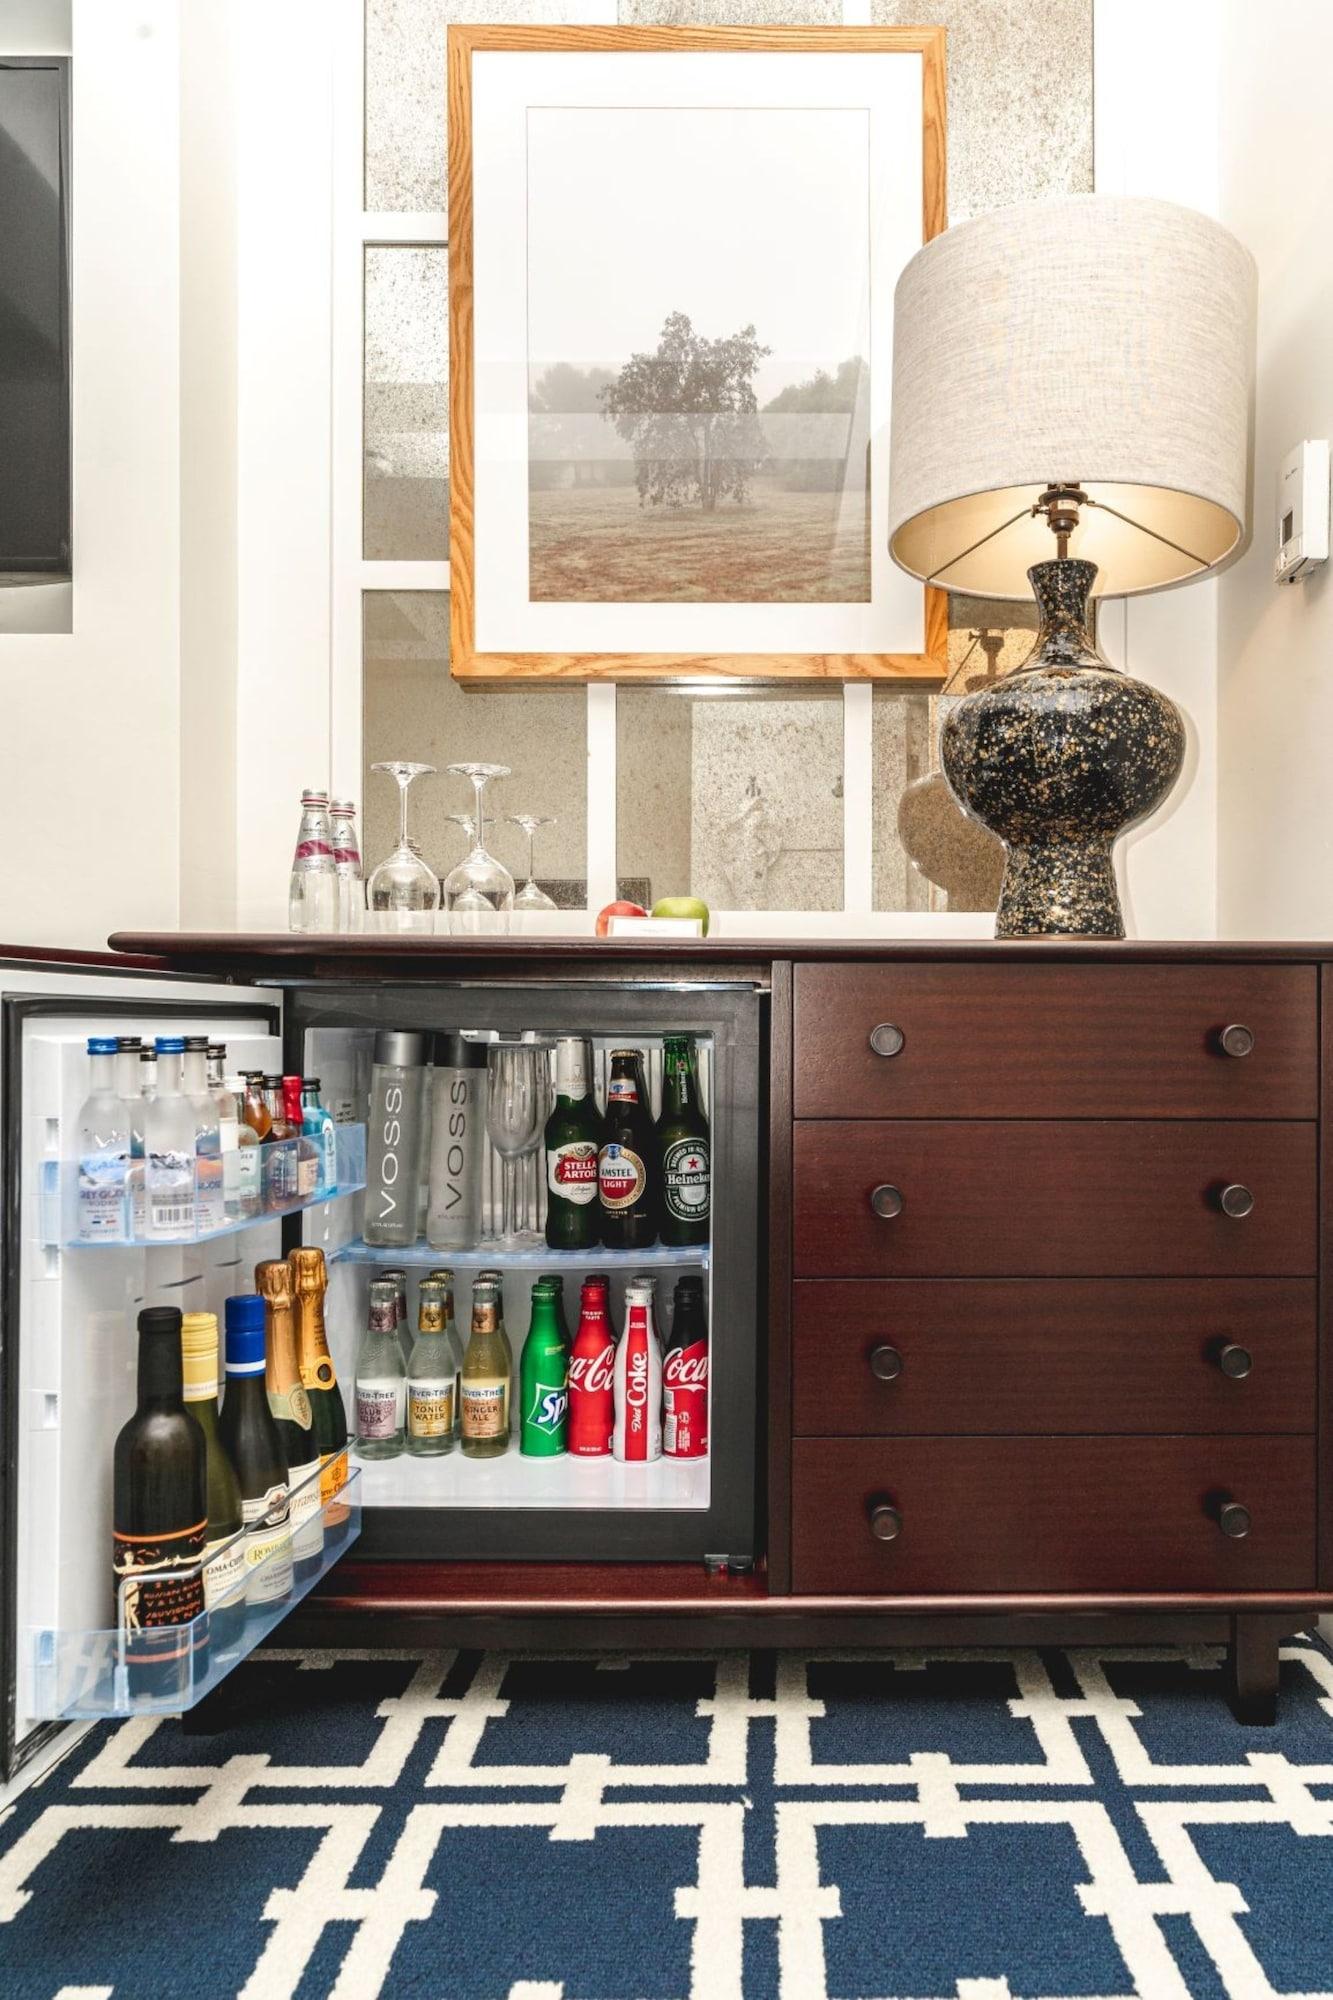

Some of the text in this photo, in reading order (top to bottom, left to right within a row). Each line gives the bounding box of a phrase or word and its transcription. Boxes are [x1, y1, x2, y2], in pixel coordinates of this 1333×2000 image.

[680, 1070, 689, 1104] Heineken
[445, 1080, 467, 1210] VOSS
[379, 1087, 402, 1218] VOSS
[564, 1160, 598, 1171] STELLA
[602, 1180, 628, 1189] LIGHT
[626, 1351, 648, 1433] Diet Coke
[415, 1405, 444, 1413] TONIC
[464, 1405, 498, 1414] GINGER
[414, 1412, 446, 1421] WATER
[472, 1413, 489, 1421] ALE
